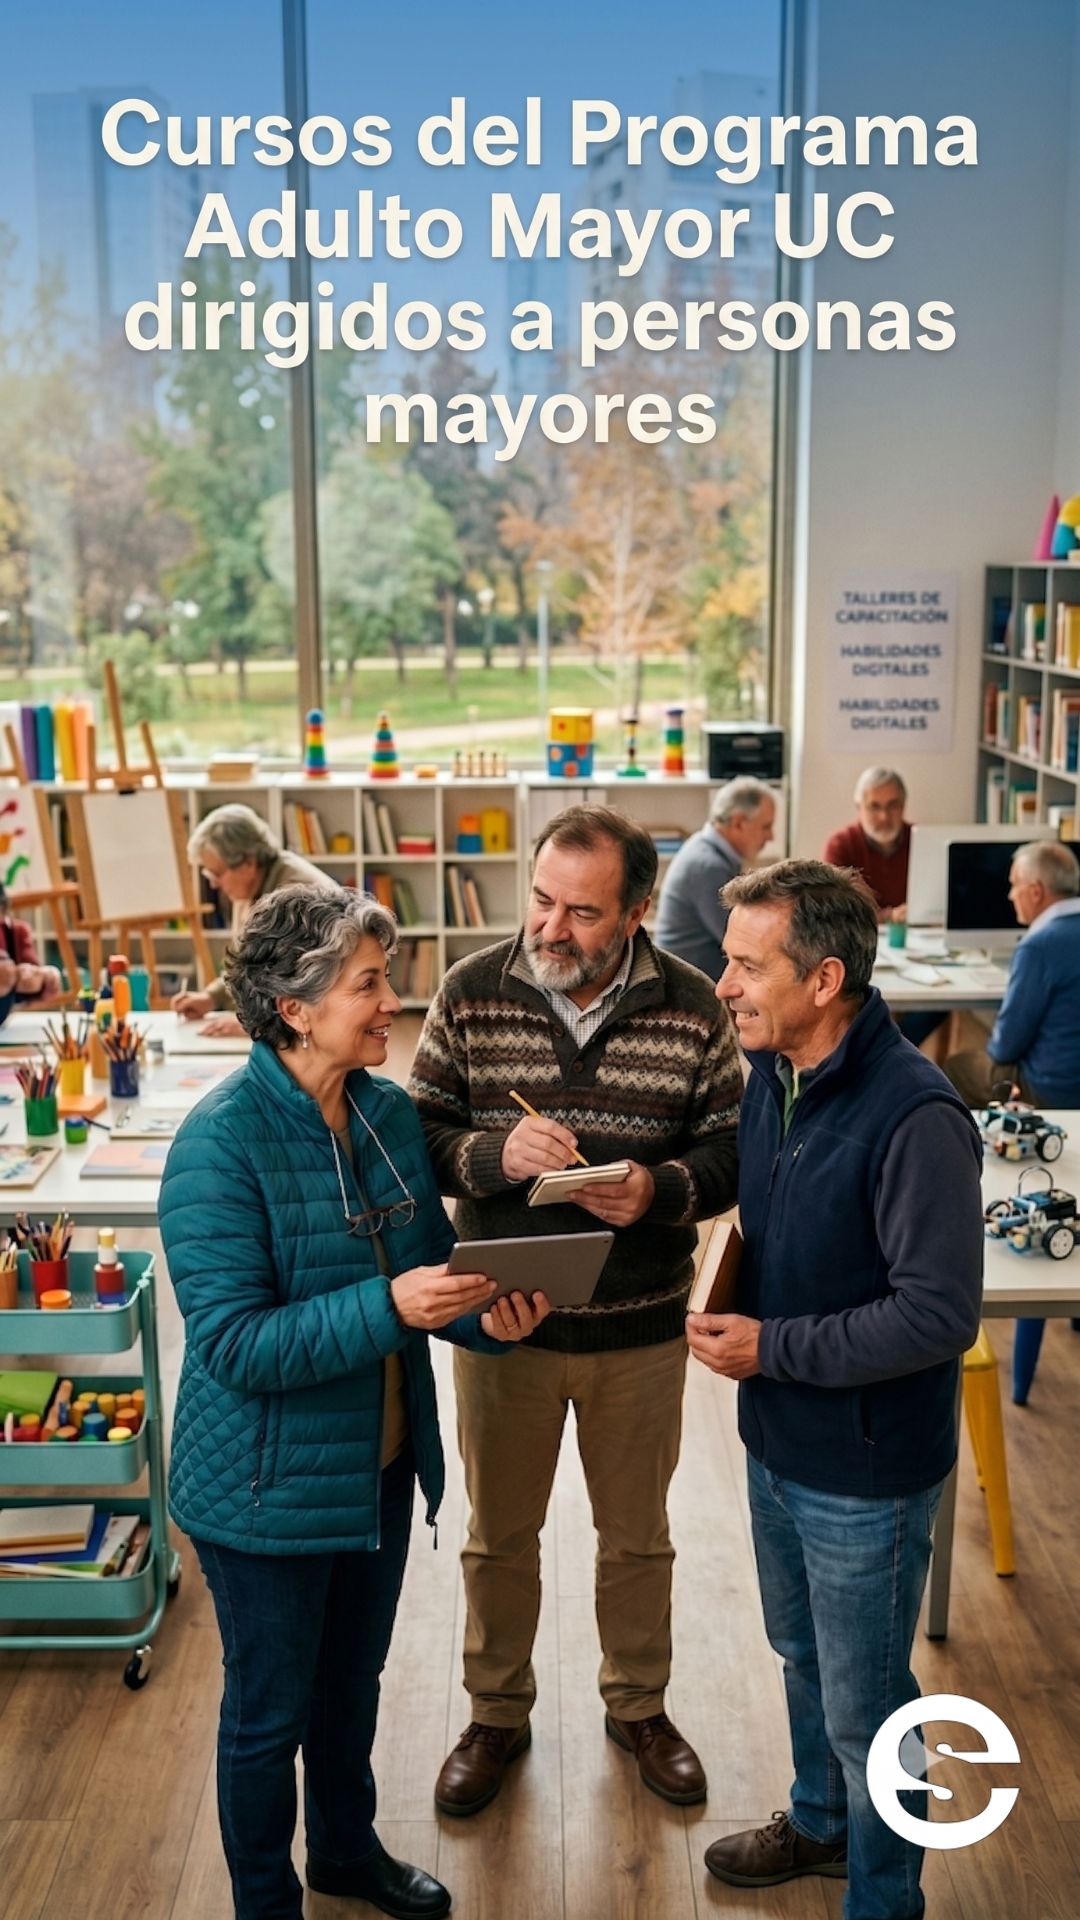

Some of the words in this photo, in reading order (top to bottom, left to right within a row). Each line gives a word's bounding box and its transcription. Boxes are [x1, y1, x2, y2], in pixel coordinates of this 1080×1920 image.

[843, 591, 917, 605] TALLERES
[921, 591, 941, 605] DE
[835, 606, 949, 624] CAPACITACIÓN
[840, 645, 942, 657] HABILIDADES
[852, 663, 930, 676] DIGITALES
[839, 698, 940, 711] HABILIDADES
[851, 717, 928, 730] DIGITALES
